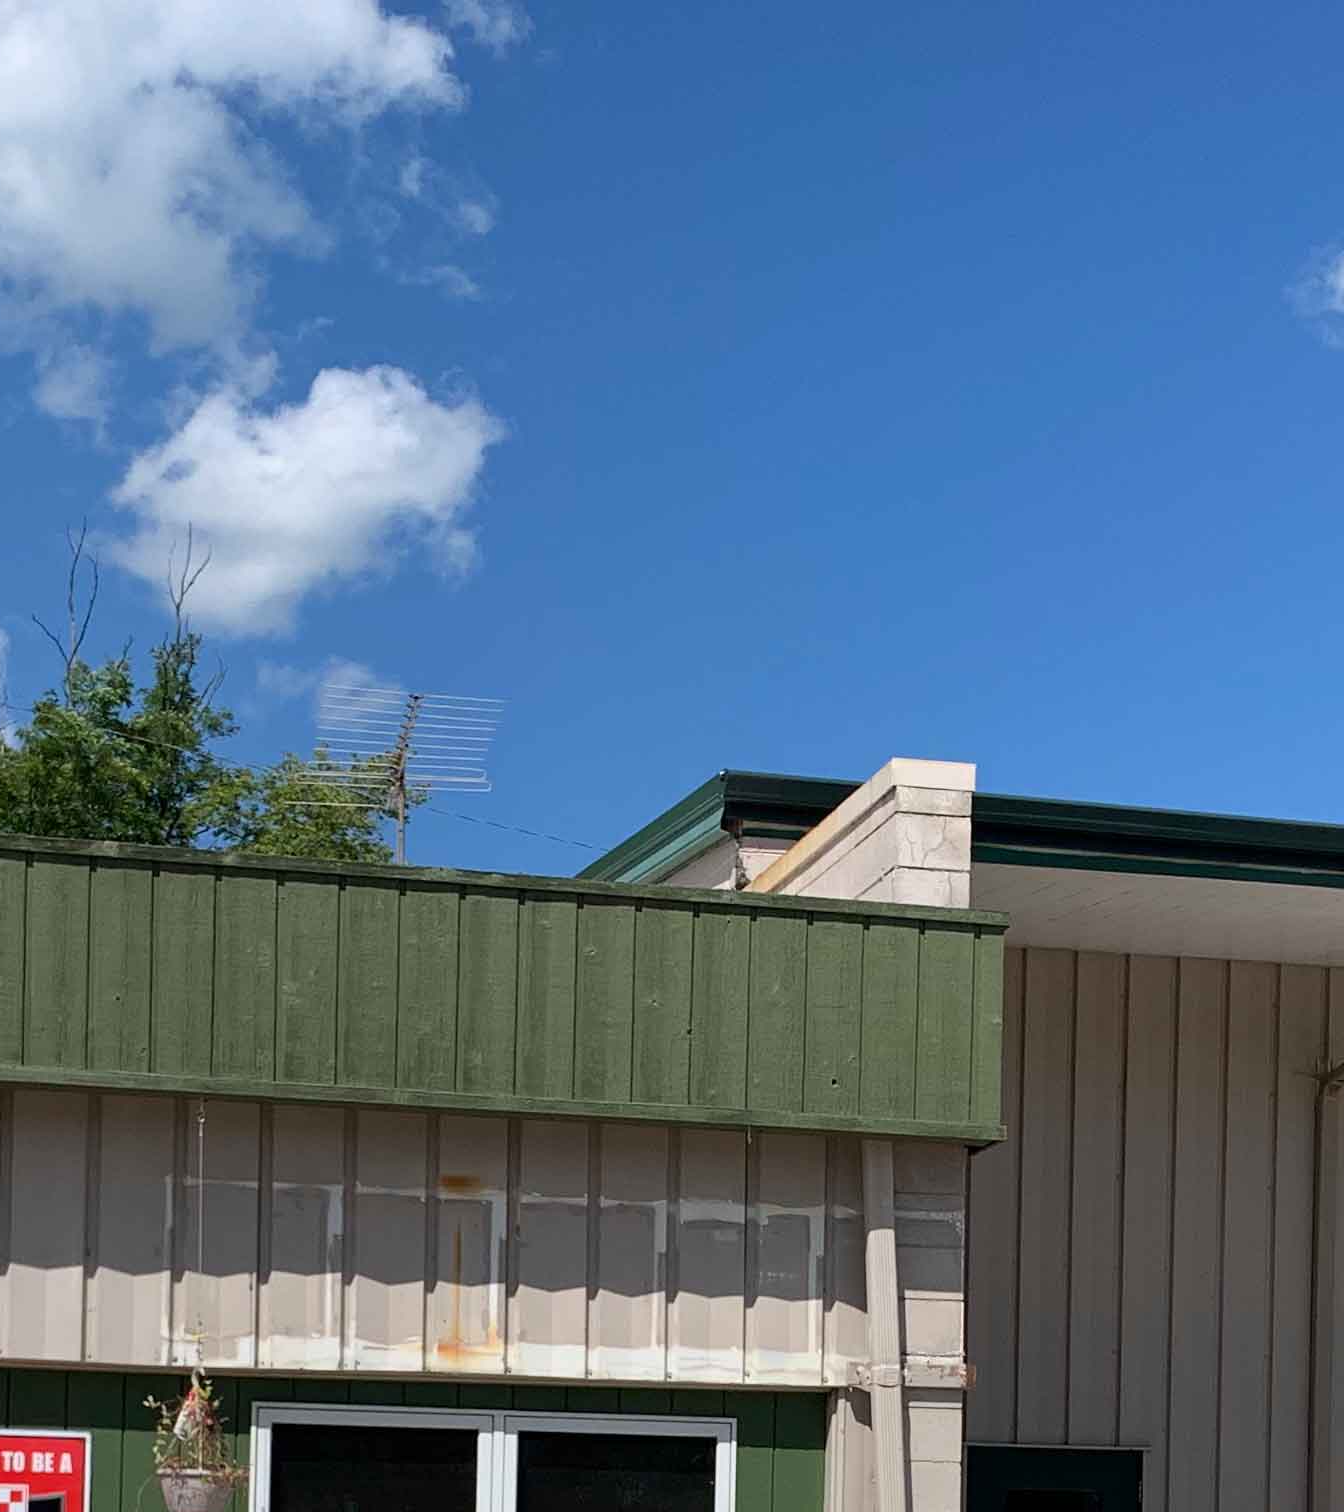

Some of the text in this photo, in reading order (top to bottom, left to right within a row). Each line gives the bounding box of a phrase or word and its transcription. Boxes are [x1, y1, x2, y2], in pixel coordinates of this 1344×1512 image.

[0, 1451, 26, 1473] TO
[31, 1451, 55, 1473] BE
[59, 1452, 73, 1474] A
